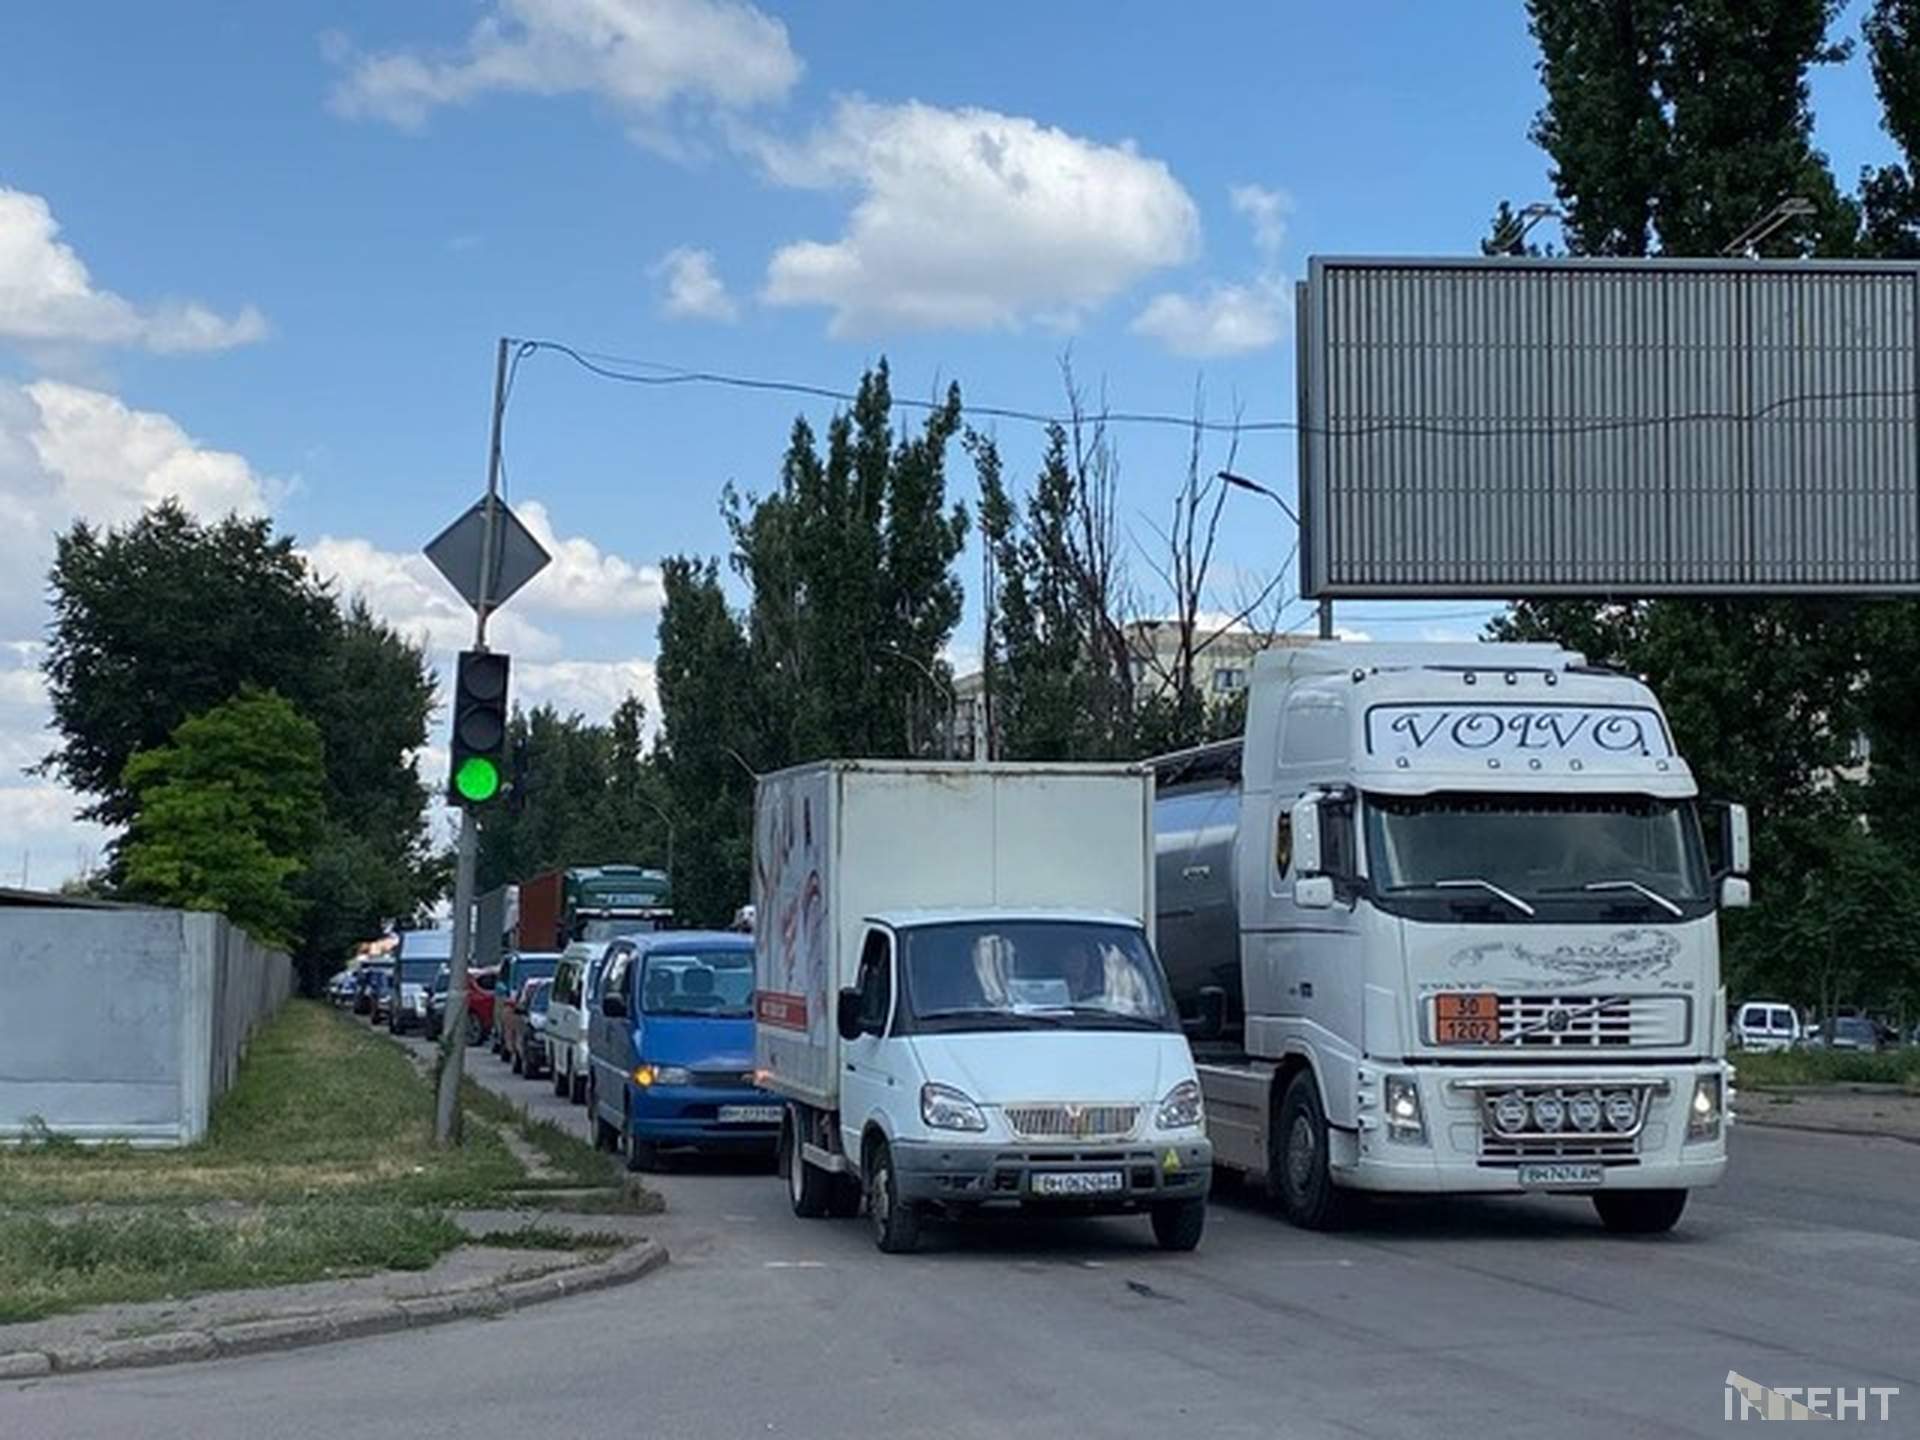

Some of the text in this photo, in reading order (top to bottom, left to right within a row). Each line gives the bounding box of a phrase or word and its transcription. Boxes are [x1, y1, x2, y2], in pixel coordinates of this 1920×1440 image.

[1392, 713, 1651, 756] VOLVO
[1457, 999, 1480, 1015] 30
[1448, 1021, 1490, 1039] 1202
